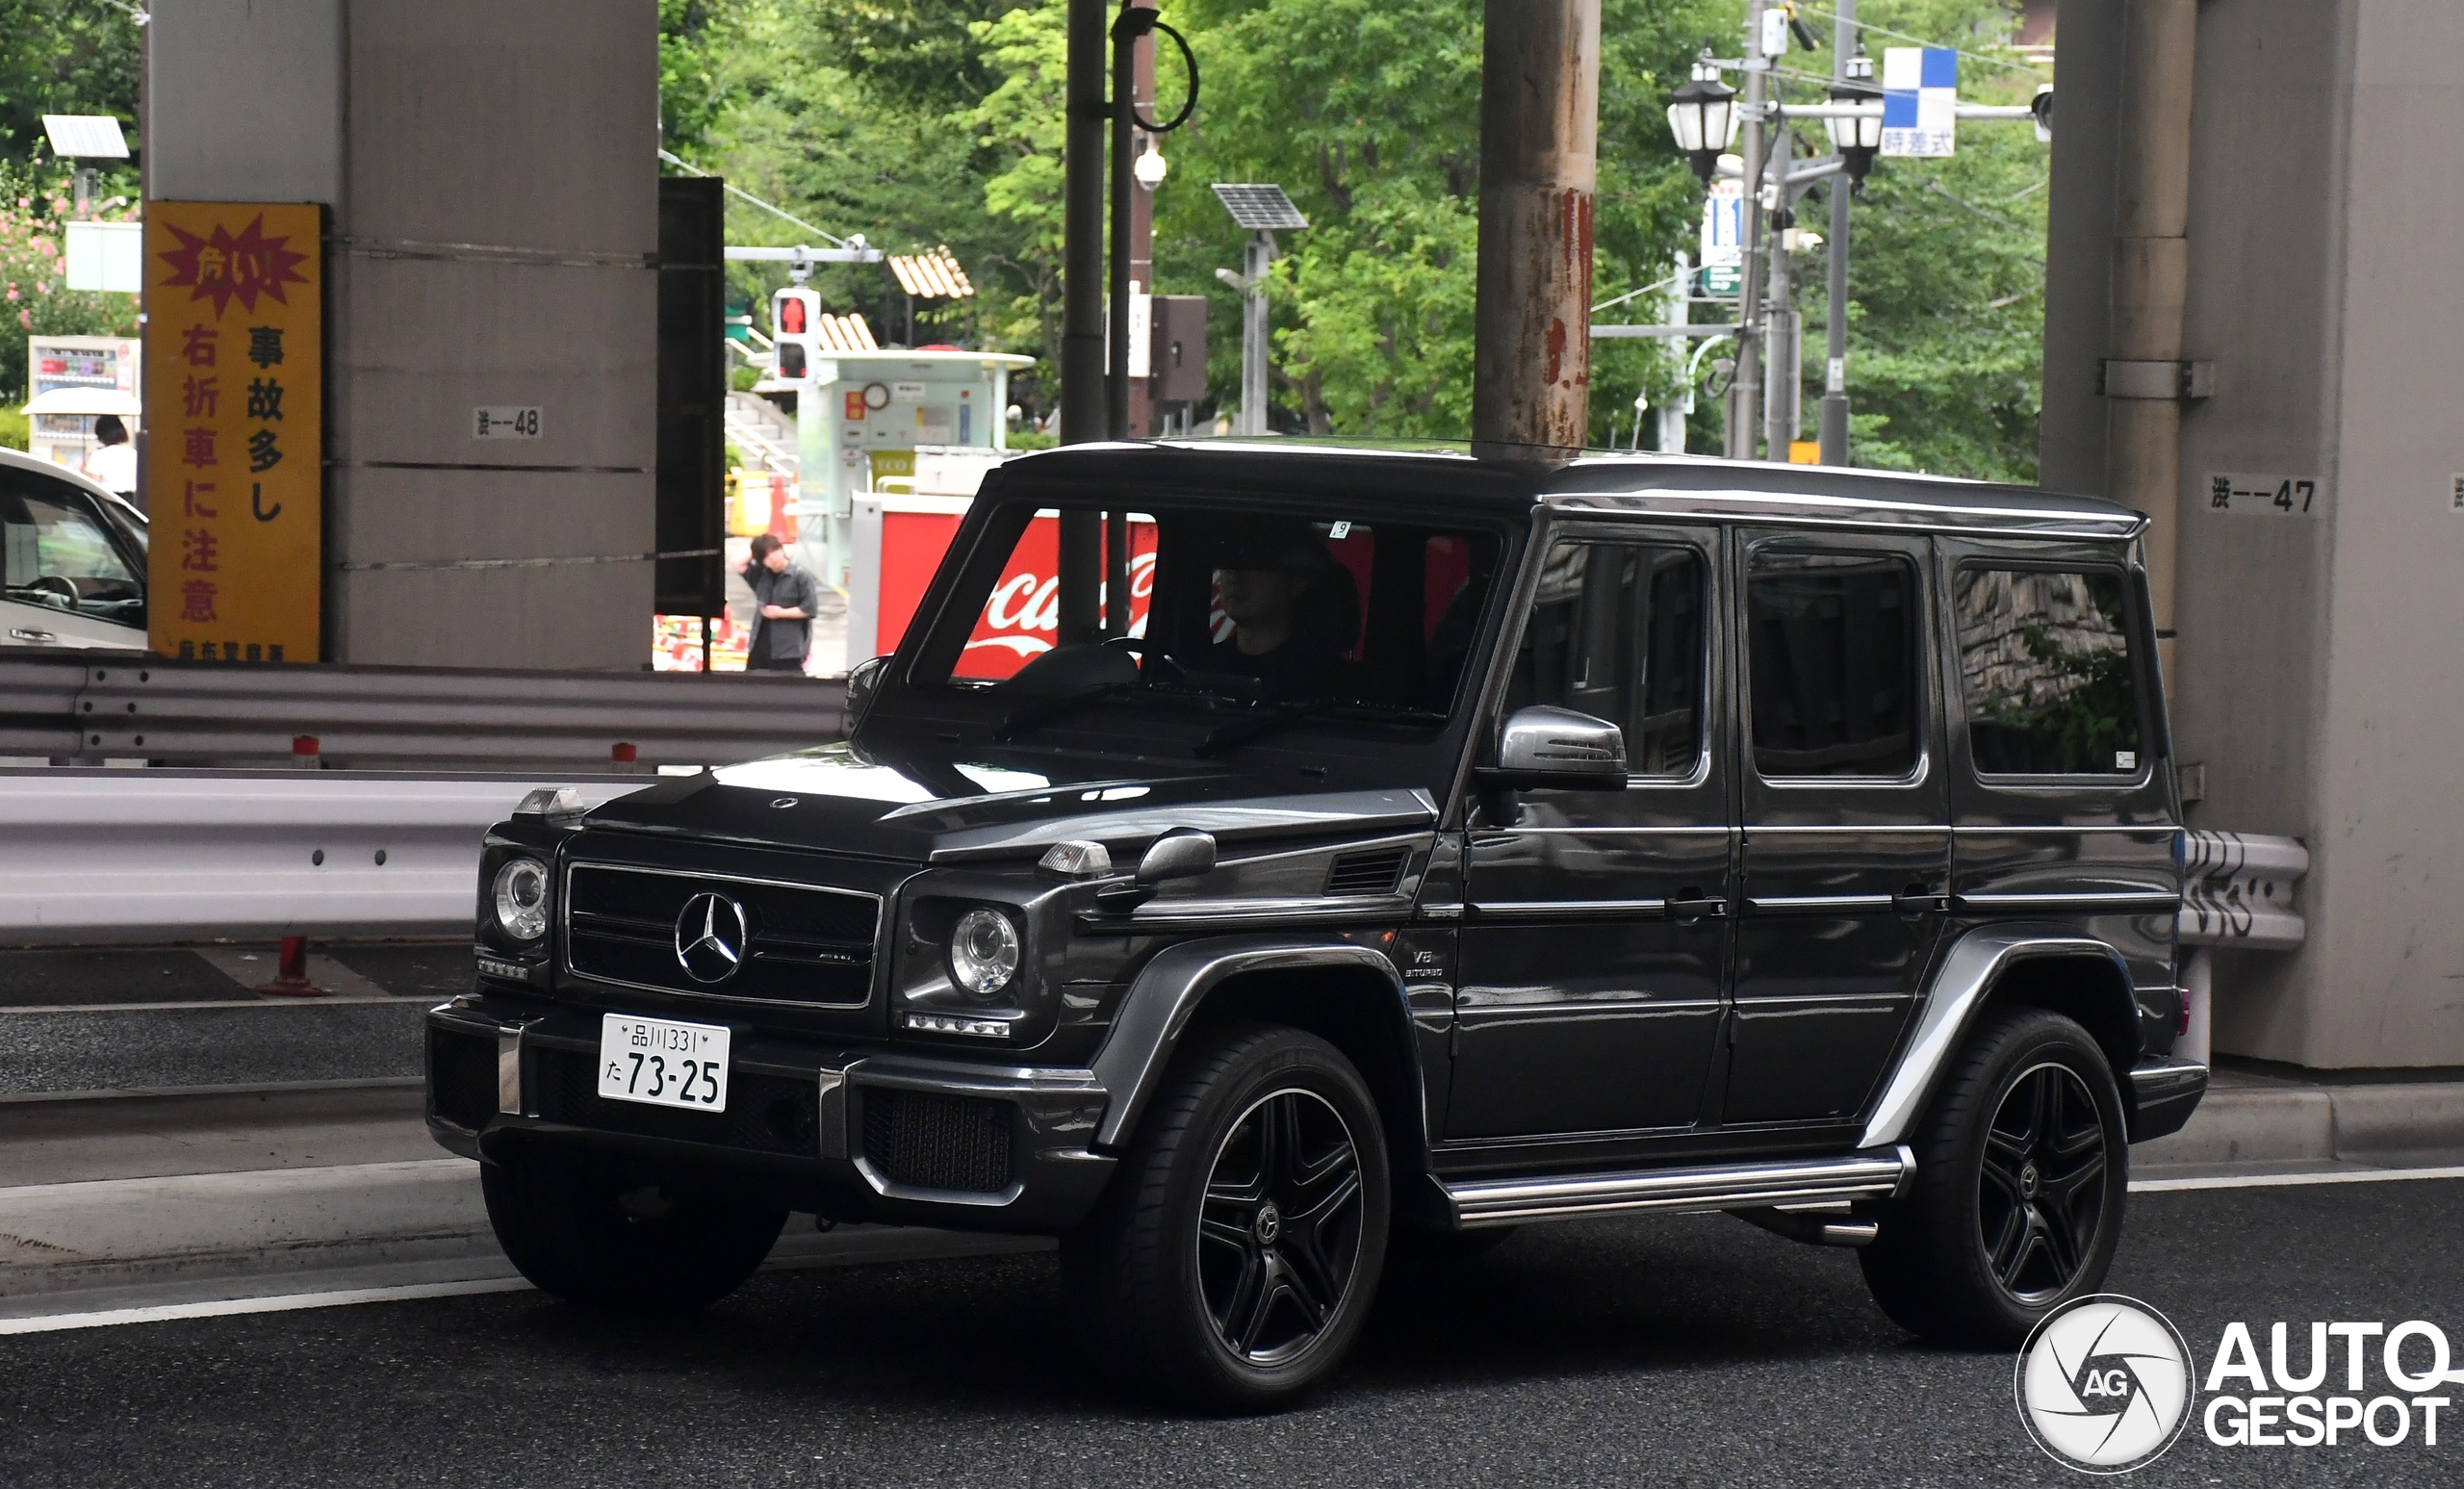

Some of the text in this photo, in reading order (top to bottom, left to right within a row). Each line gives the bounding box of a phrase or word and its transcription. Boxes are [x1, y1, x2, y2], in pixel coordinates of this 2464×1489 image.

[1885, 130, 1951, 153] 時差式
[247, 325, 284, 523] 事故多し
[182, 322, 219, 624] 右折車に注意
[1413, 951, 1432, 963] V8
[1405, 968, 1443, 977] BITURBO
[631, 1025, 697, 1052] 品川 331
[606, 1052, 720, 1103] た 73-25
